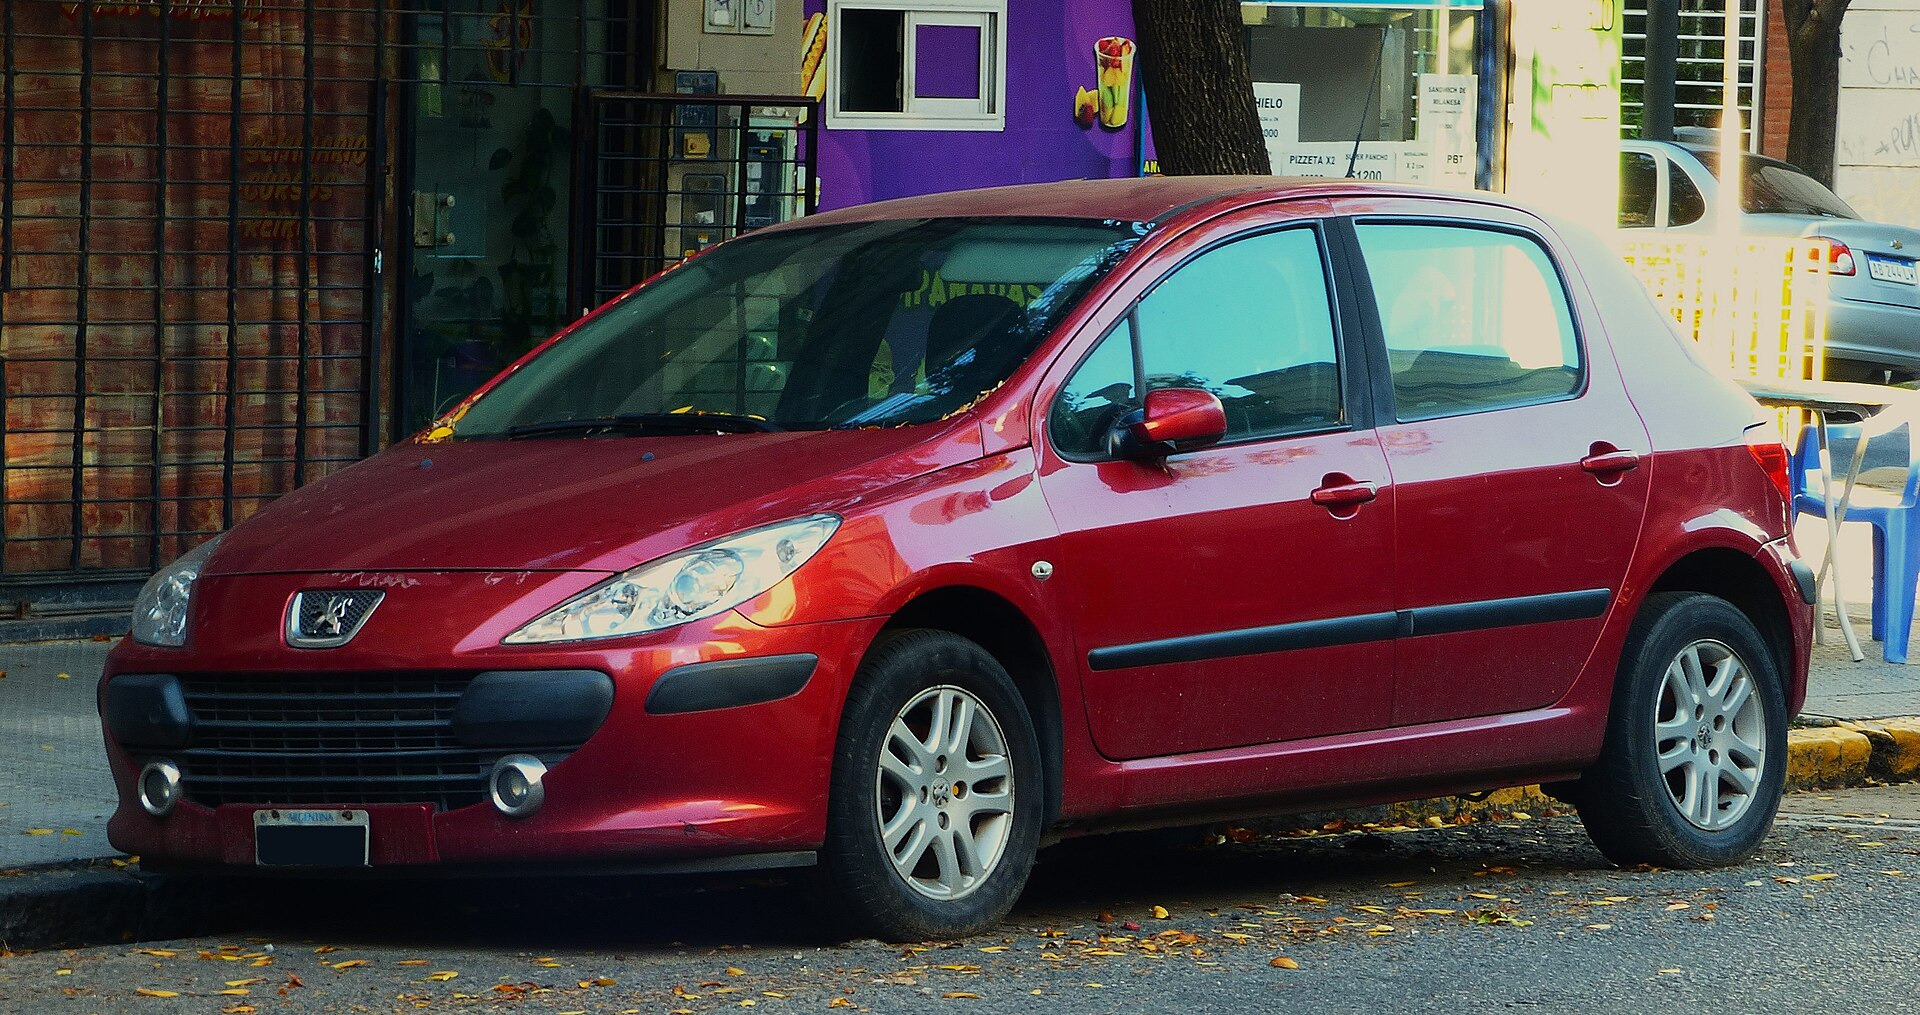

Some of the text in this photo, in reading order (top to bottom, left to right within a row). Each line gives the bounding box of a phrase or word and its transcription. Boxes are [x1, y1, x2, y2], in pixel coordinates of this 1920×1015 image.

[1459, 86, 1467, 94] DE
[1255, 98, 1283, 109] HIELO
[1289, 155, 1336, 165] PIZZETA X2
[1345, 153, 1364, 161] SUER
[287, 812, 334, 823] ARGENTINA
